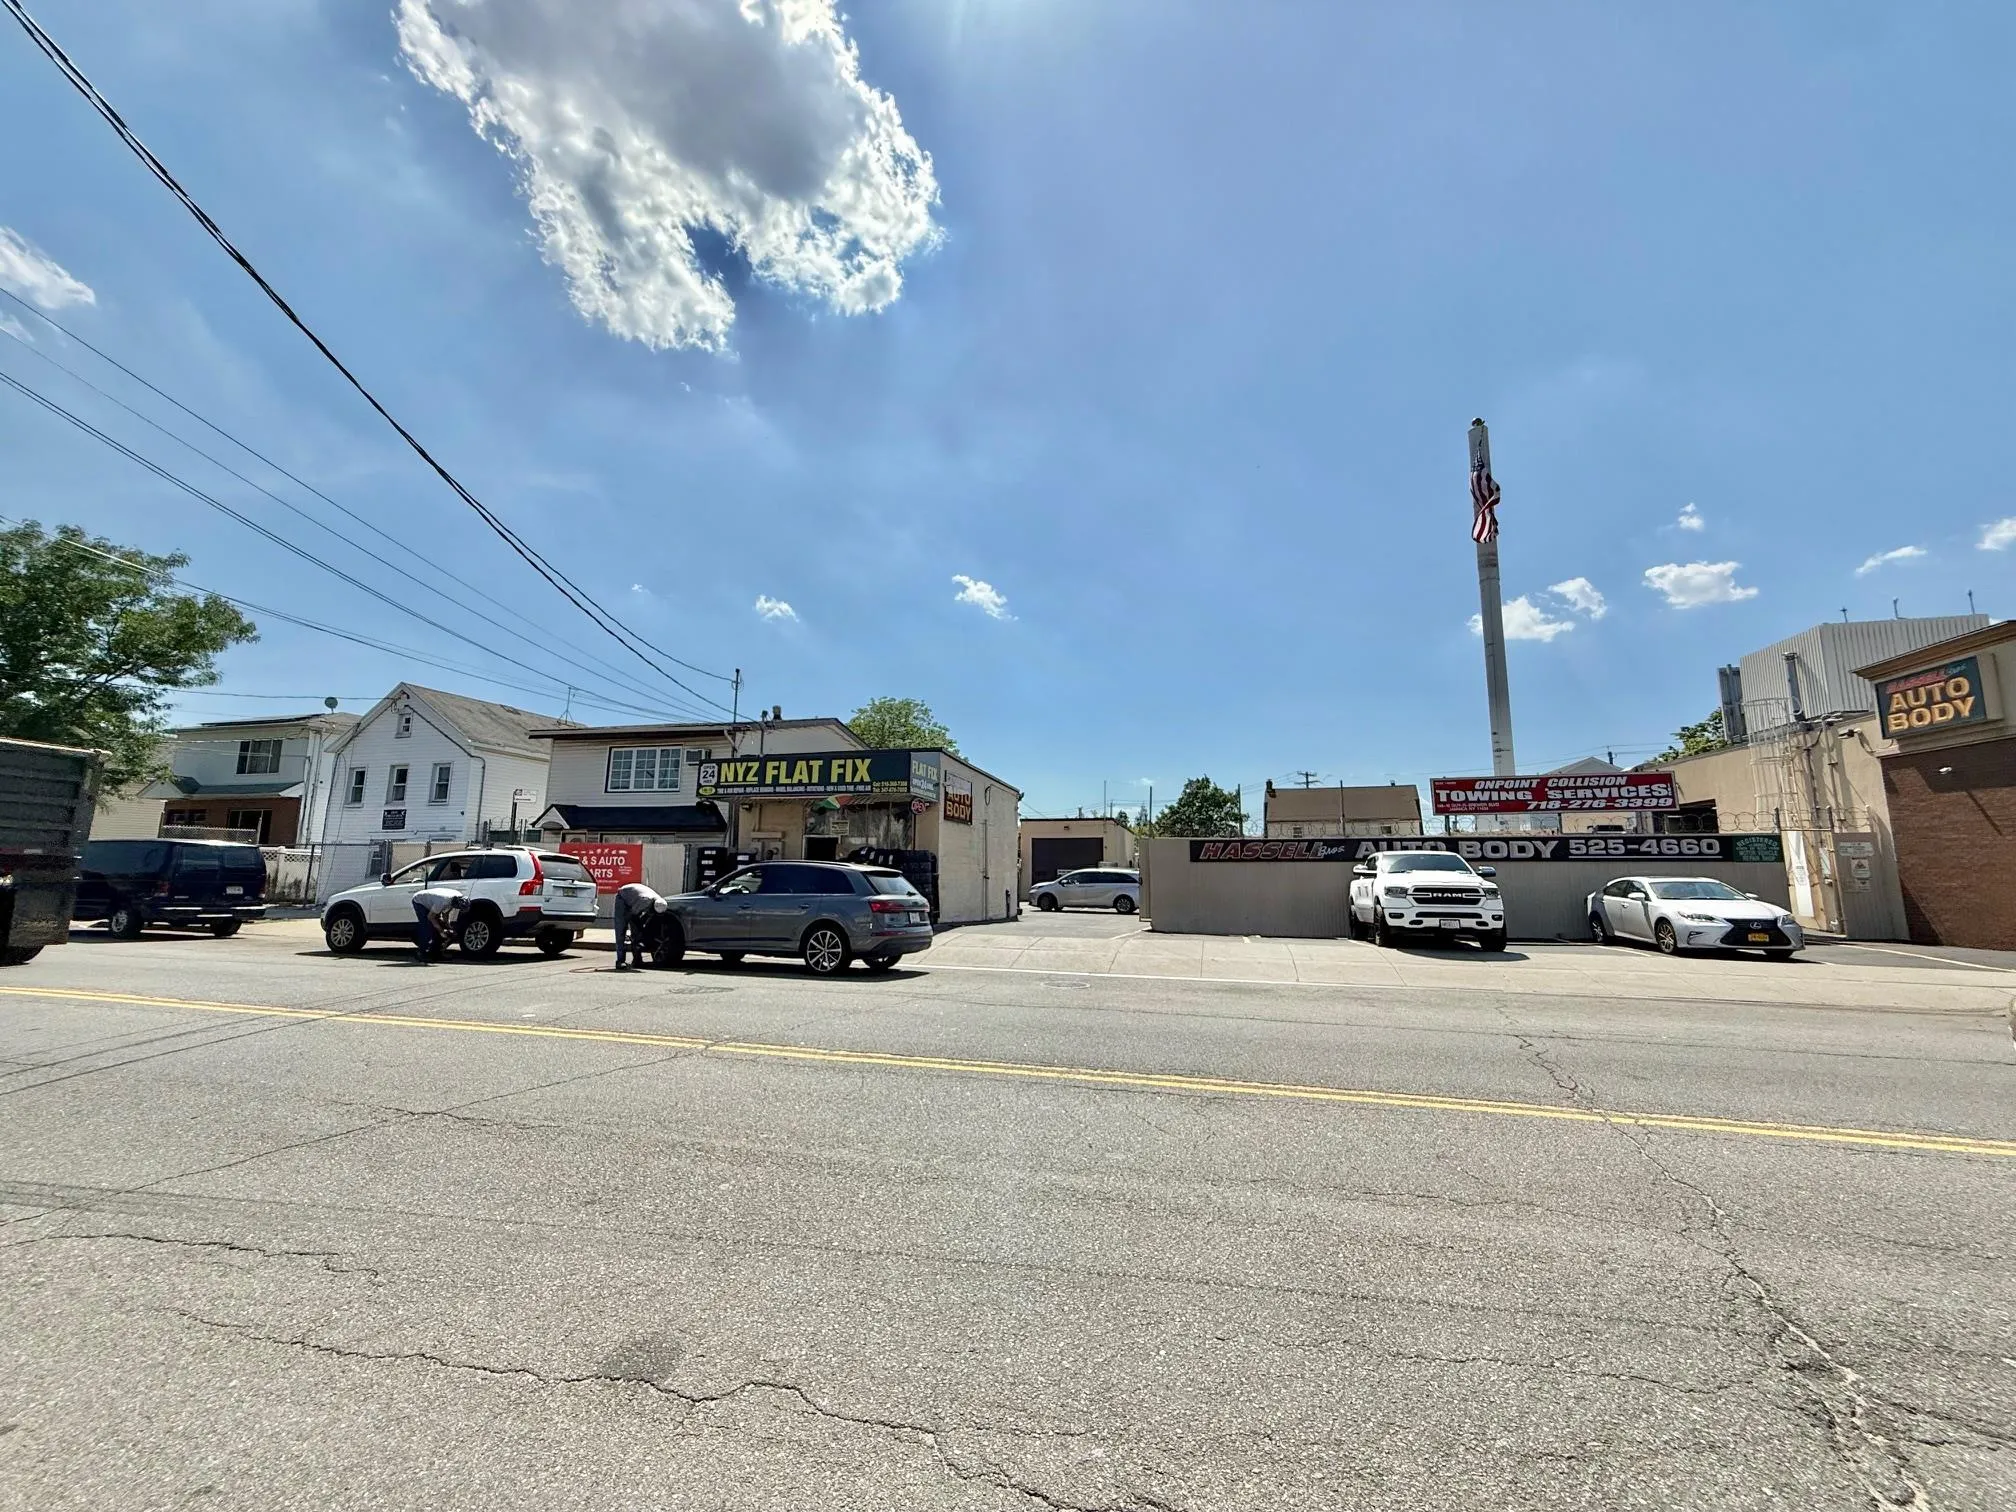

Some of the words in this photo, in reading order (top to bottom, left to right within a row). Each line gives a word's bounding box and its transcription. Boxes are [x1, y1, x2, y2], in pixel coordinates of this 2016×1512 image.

[1889, 676, 1970, 713] AUTO
[1887, 696, 1975, 733] BODY
[702, 769, 716, 779] 24
[720, 761, 760, 782] NYZ
[765, 760, 823, 784] FLAT
[830, 758, 872, 783] FIX
[912, 760, 926, 777] FLAT
[927, 765, 938, 781] FIX
[1474, 779, 1540, 790] ONPOINT
[1547, 776, 1628, 787] COLLISION
[1436, 789, 1533, 802] TOWING
[1527, 797, 1673, 810] 718-276-3399
[946, 800, 971, 820] BODY
[1200, 841, 1324, 860] HASSELL
[1354, 840, 1447, 859] AUTO
[1458, 840, 1559, 859] BODY
[1569, 838, 1721, 855] 525-4660
[581, 856, 588, 865] &
[590, 856, 597, 865] S
[598, 856, 626, 866] AUTO
[589, 868, 613, 878] ARTS
